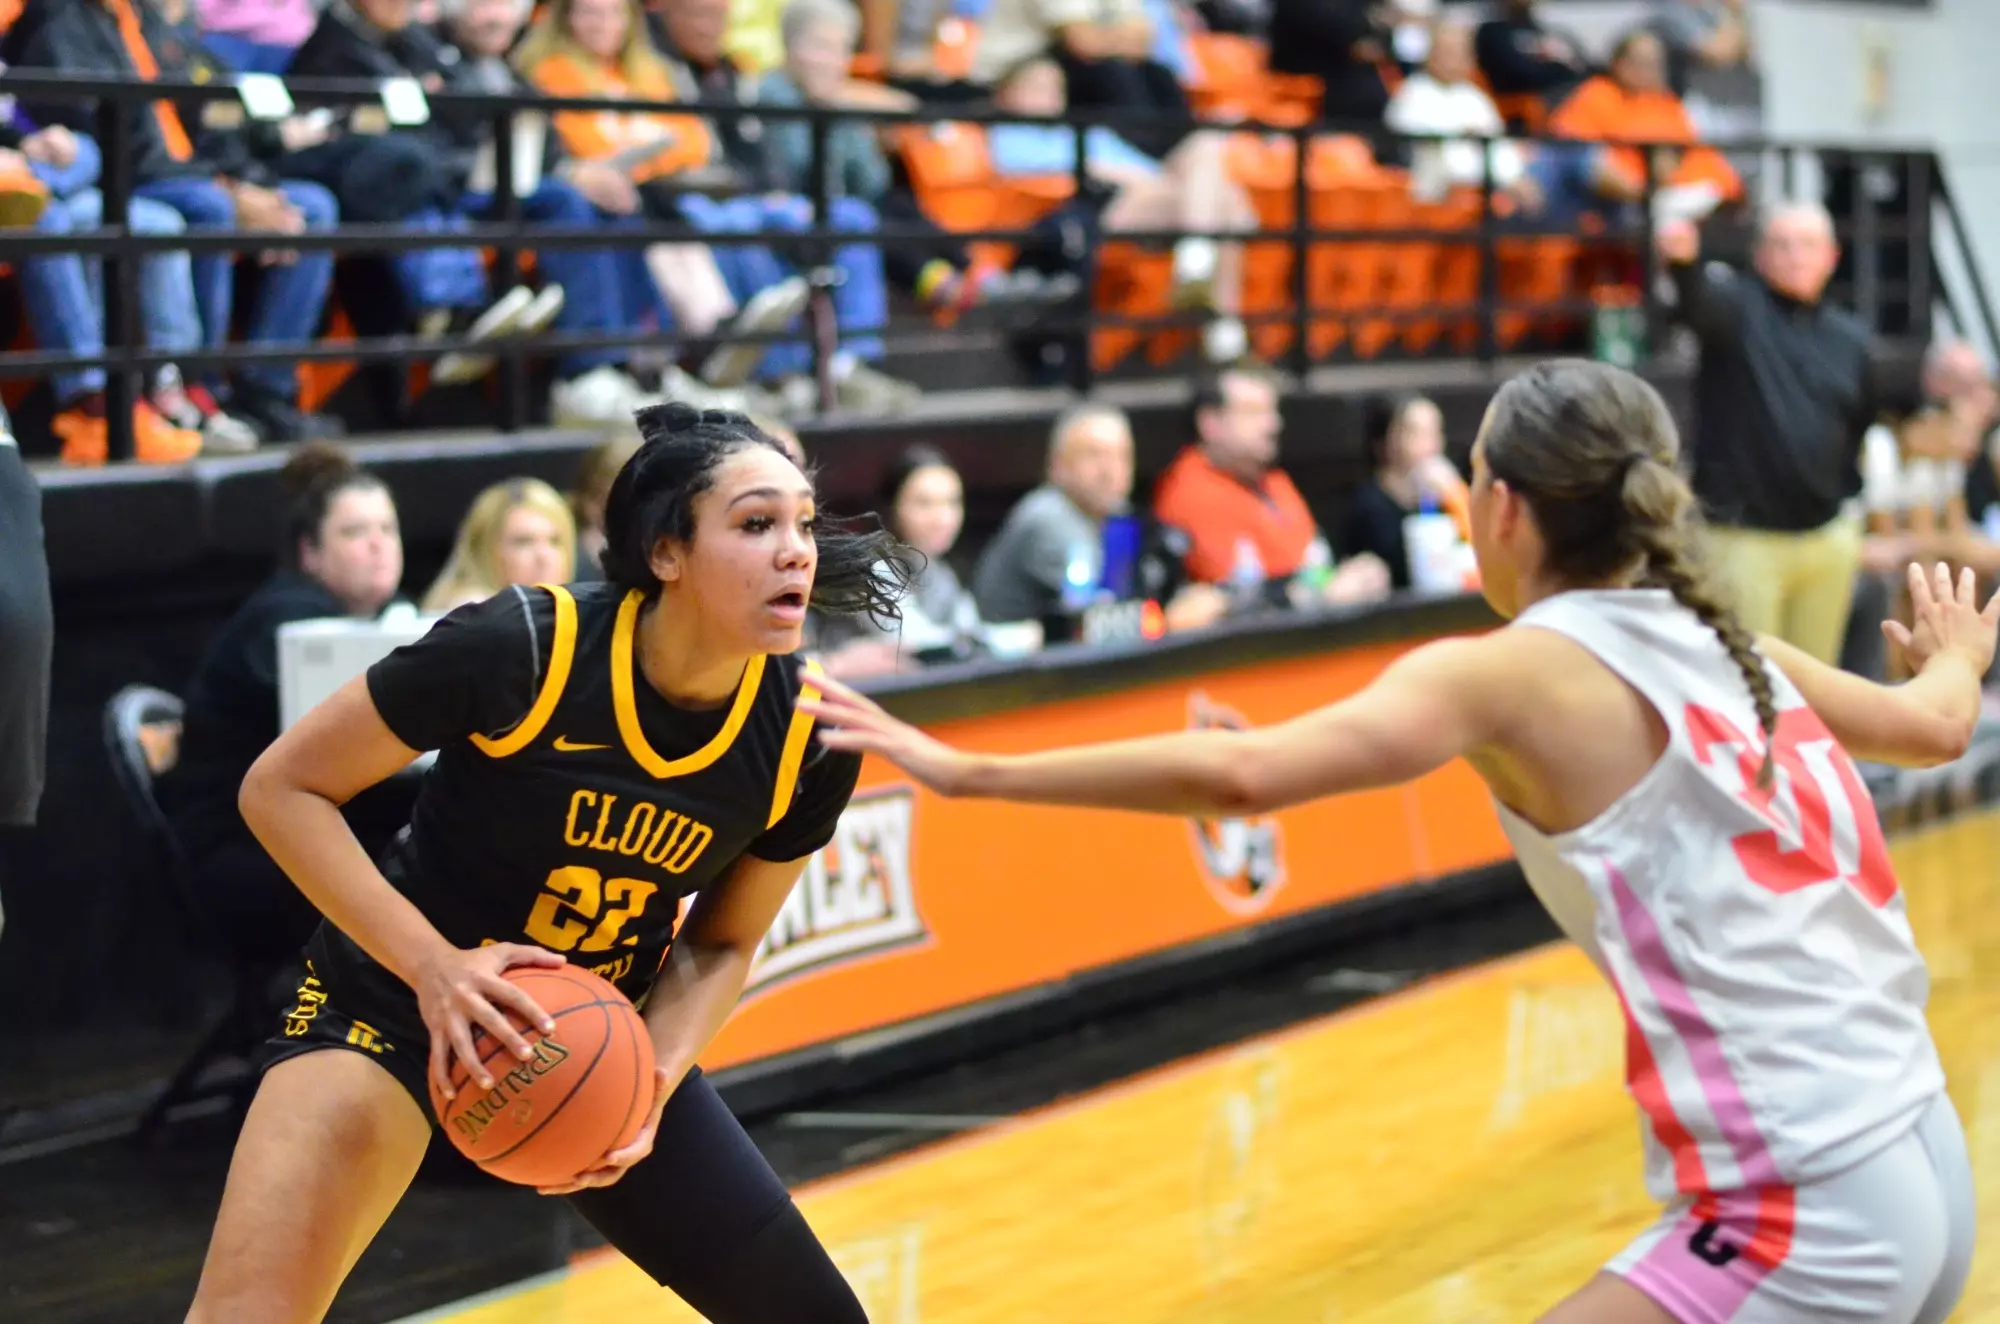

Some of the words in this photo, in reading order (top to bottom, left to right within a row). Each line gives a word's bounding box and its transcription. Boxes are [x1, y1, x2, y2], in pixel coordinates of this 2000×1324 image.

[564, 788, 714, 875] CLOUD
[525, 865, 659, 953] 22
[452, 1035, 569, 1146] SPALDING
